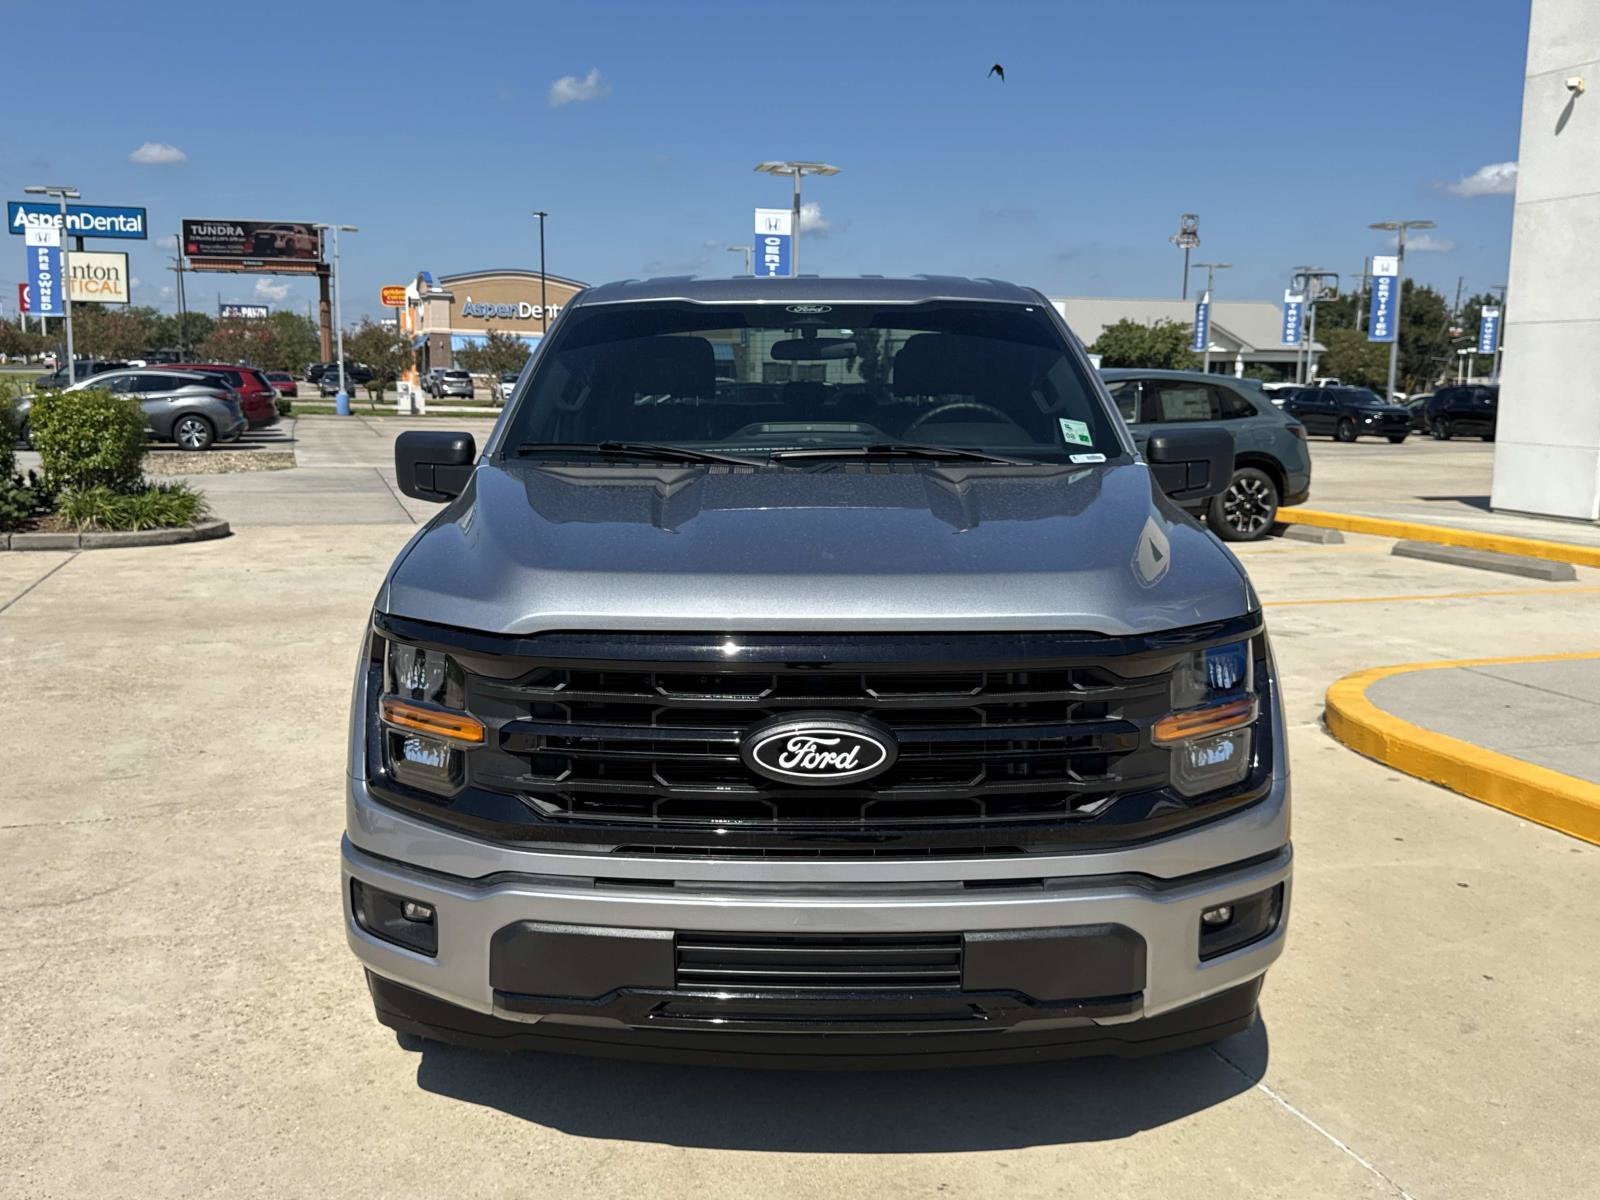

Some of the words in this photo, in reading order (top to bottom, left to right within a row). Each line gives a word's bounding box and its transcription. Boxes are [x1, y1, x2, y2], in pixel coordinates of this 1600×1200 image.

[13, 206, 142, 232] AspenDental
[190, 225, 245, 236] TUNDRA
[38, 272, 53, 311] OWNED
[463, 296, 564, 321] AspenDent
[779, 736, 860, 769] Ford
